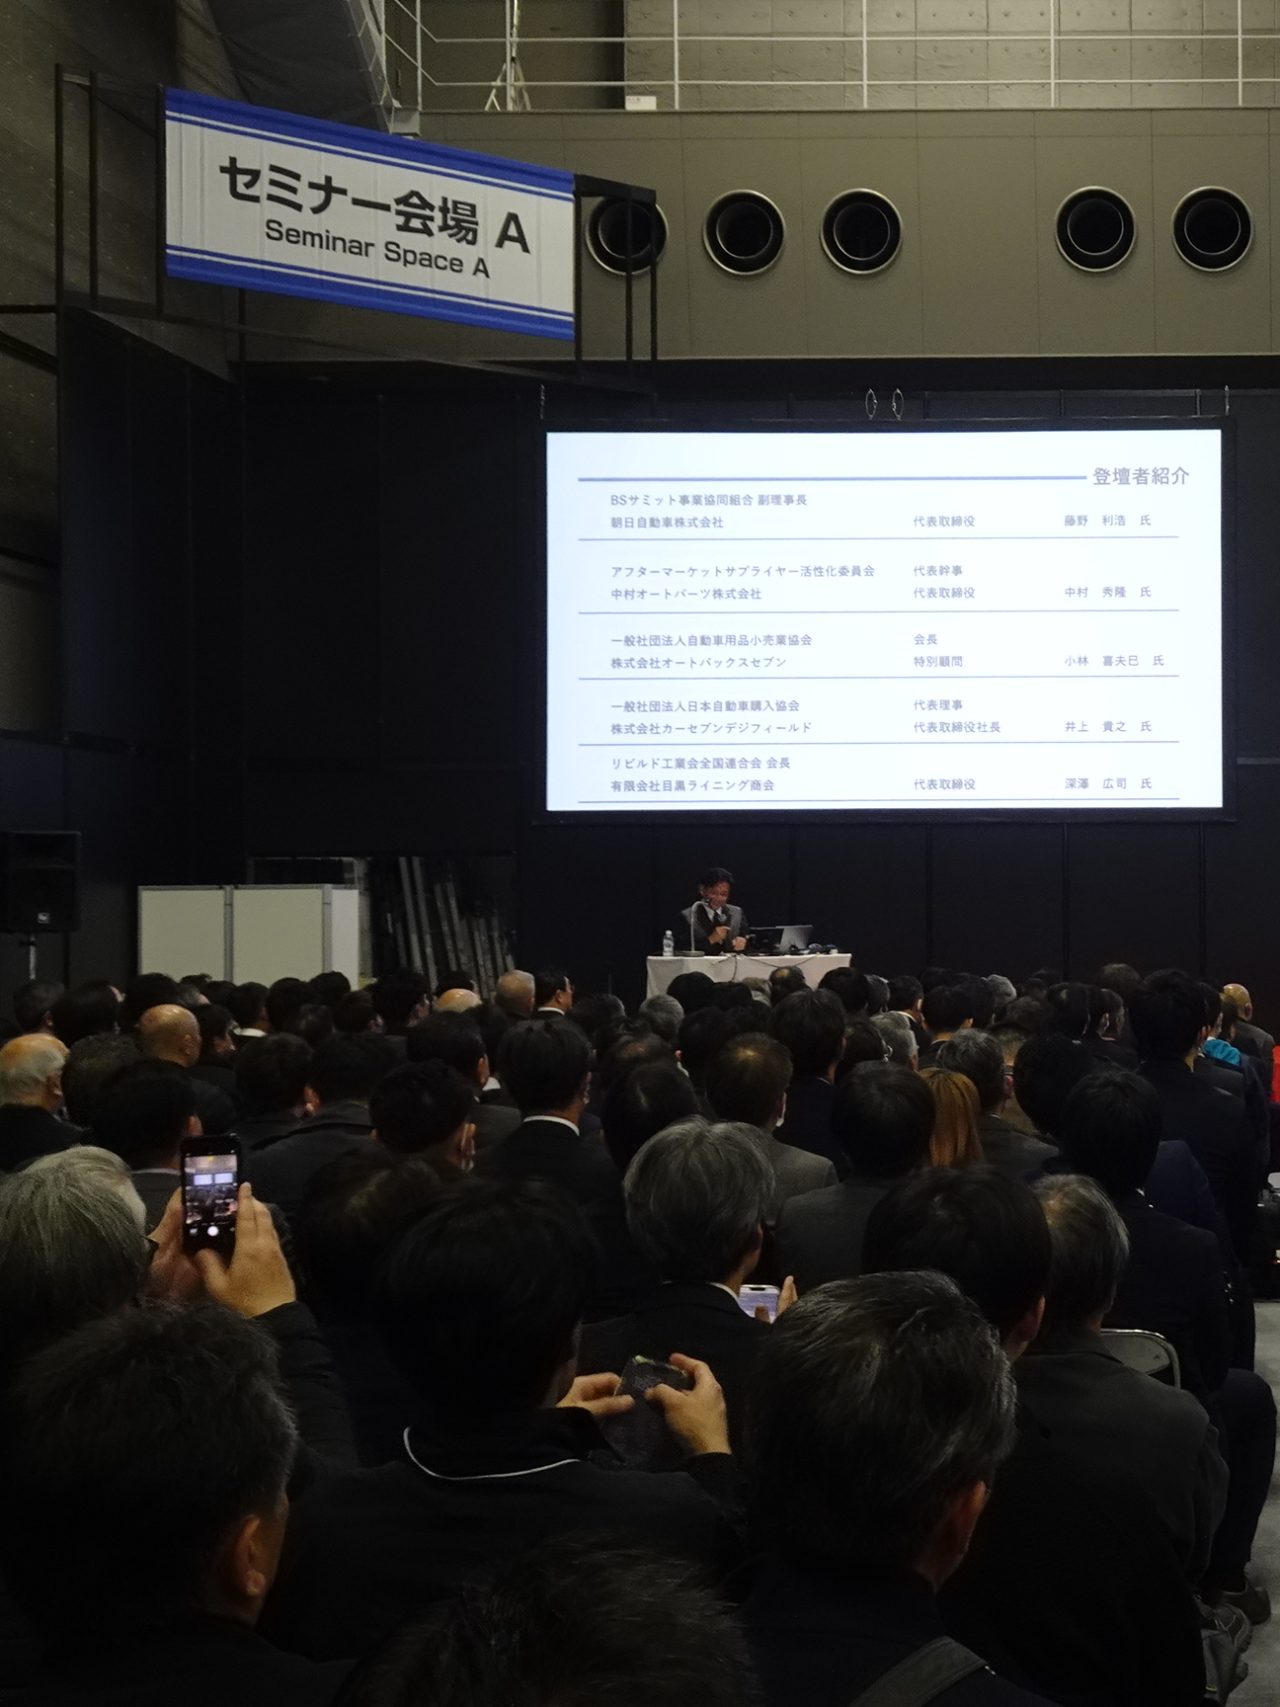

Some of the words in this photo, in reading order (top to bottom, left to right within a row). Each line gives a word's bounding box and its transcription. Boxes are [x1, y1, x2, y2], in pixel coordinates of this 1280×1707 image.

[219, 156, 478, 246] セミナー会場
[495, 212, 531, 254] A
[265, 219, 375, 258] Seminar
[384, 241, 464, 274] Space
[472, 257, 491, 279] A
[1093, 466, 1189, 486] 登壇者紹介
[611, 494, 753, 506] BSサミット事業協同組合
[758, 494, 807, 506] 副理事長
[611, 516, 724, 529] 朝日自動車株式会社
[1140, 515, 1151, 526] 氏
[913, 565, 962, 577] 代表幹事
[1065, 587, 1088, 598] 中村
[1140, 586, 1151, 598] 氏
[611, 634, 812, 647] 一般社団法人自動車用品小売業協会
[913, 634, 937, 645] 会長
[611, 656, 786, 669] 株式会社オートバックスセブン
[913, 656, 962, 667] 特別顧問
[1065, 655, 1088, 667] 小林
[1153, 655, 1164, 666] 氏
[913, 699, 962, 711] 代表理事
[611, 722, 812, 735] 株式会社カーセブンデジフィールド
[913, 721, 1000, 733] 代表取締役社長
[1065, 721, 1088, 733] 井上
[1141, 721, 1152, 732] 氏
[611, 757, 761, 769] リビルド工業会全国連合会
[766, 757, 790, 769] 会長
[1103, 778, 1127, 789] 広司
[1141, 778, 1152, 789] 氏
